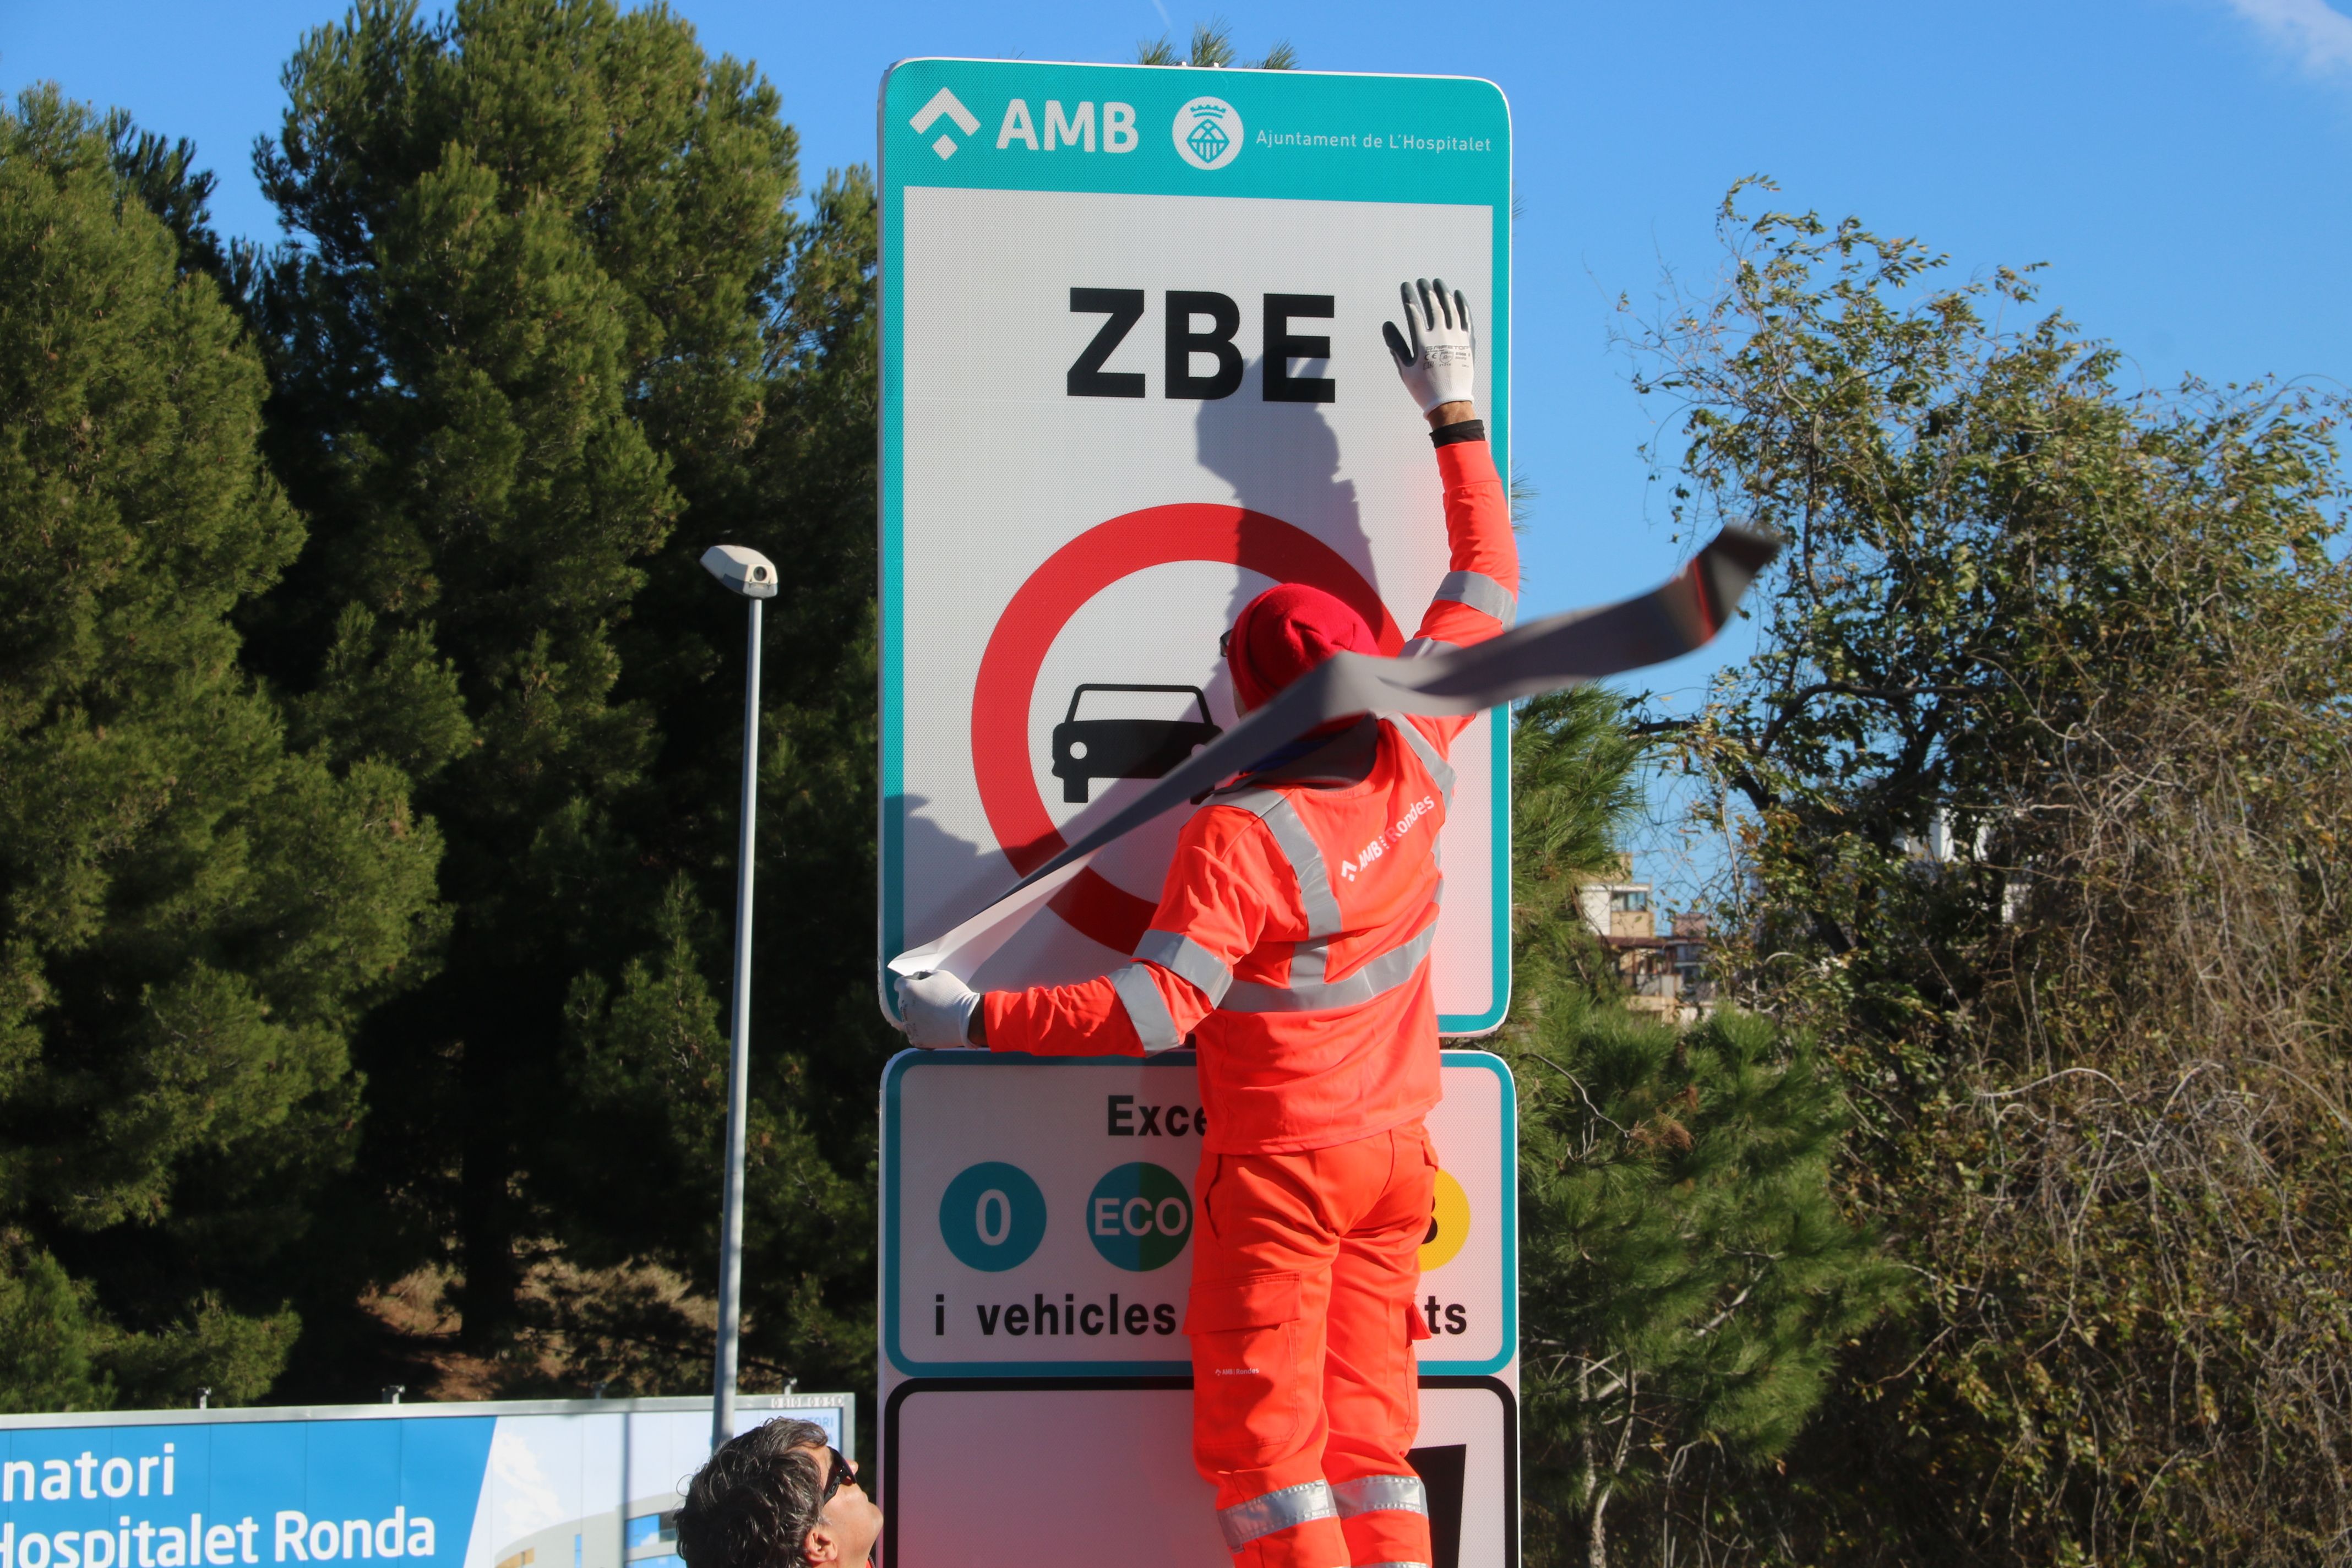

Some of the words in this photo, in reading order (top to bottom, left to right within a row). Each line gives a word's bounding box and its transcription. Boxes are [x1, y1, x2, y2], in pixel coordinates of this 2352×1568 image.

[996, 98, 1139, 154] AMB
[1256, 129, 1357, 148] Ajuntament
[1363, 133, 1382, 148] de
[1067, 287, 1336, 403] ZBE
[1358, 840, 1384, 872] AMB
[1384, 795, 1435, 843] Rondes
[1108, 1095, 1207, 1137] Exce
[1095, 1197, 1188, 1237] ECO
[935, 1294, 945, 1336] i
[976, 1293, 1177, 1336] vehicles
[1235, 1367, 1260, 1375] Rondes
[3, 1442, 175, 1502] natori
[274, 1506, 435, 1562] Ronda
